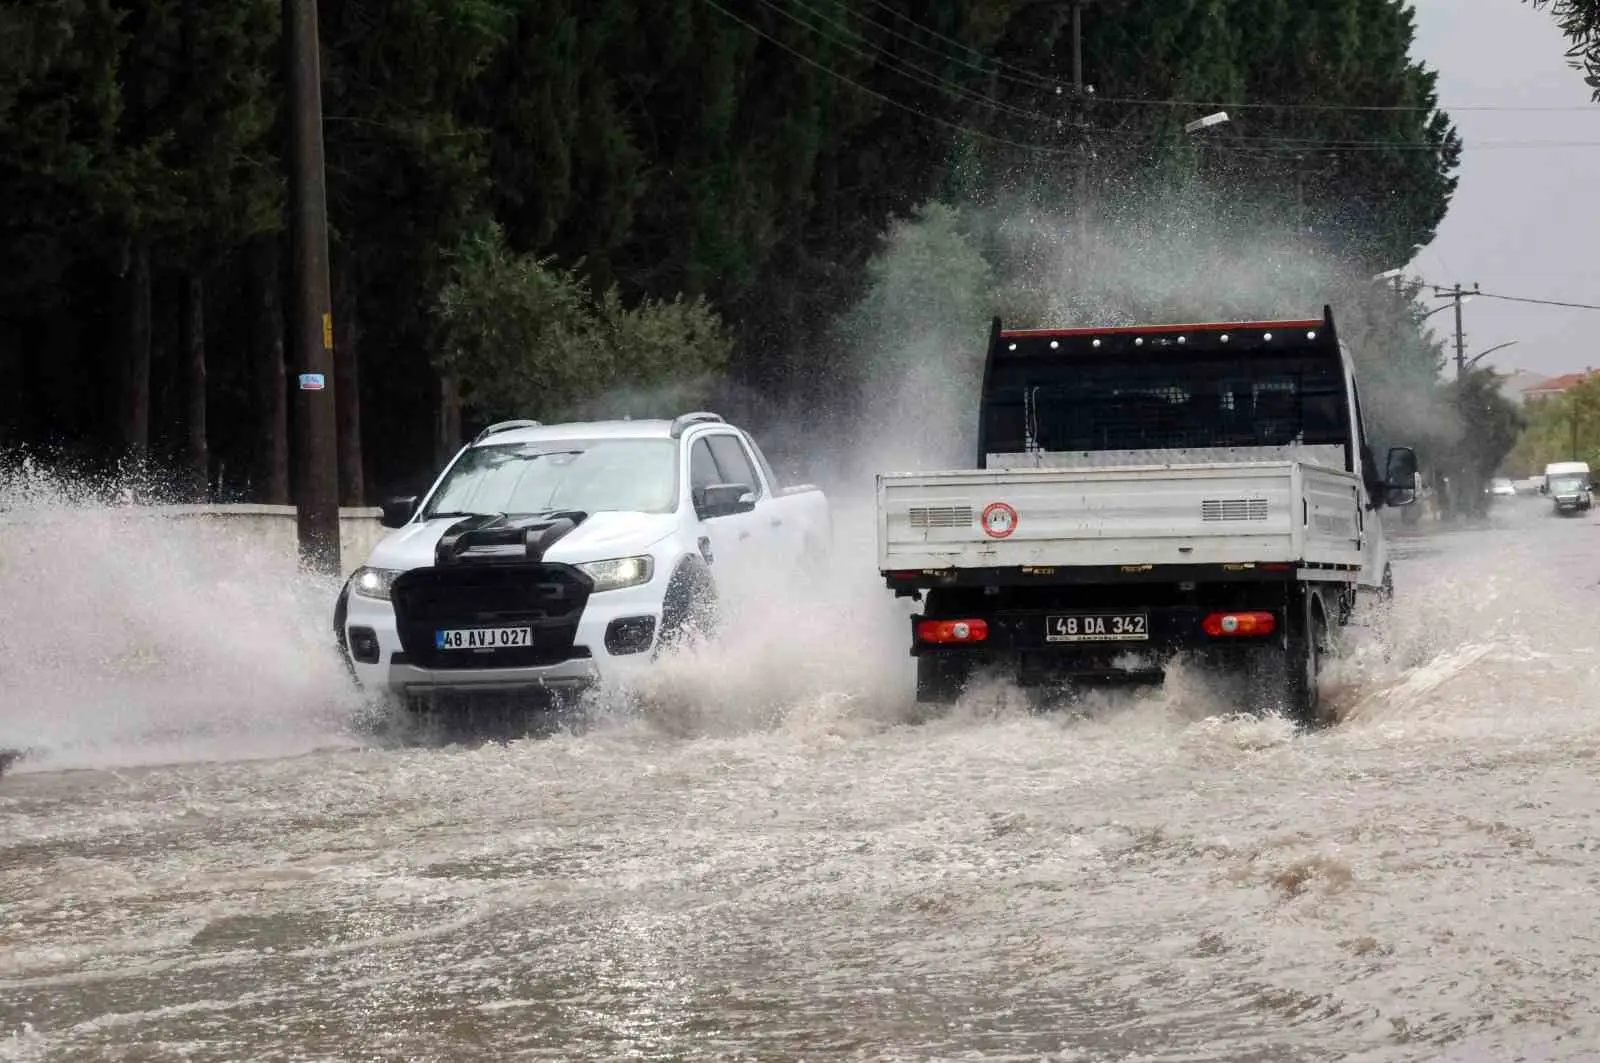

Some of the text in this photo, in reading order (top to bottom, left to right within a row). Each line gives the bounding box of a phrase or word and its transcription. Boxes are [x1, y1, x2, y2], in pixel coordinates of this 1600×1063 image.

[1056, 616, 1145, 635] 48 DA 342
[444, 629, 529, 647] 48 AVJ 027
